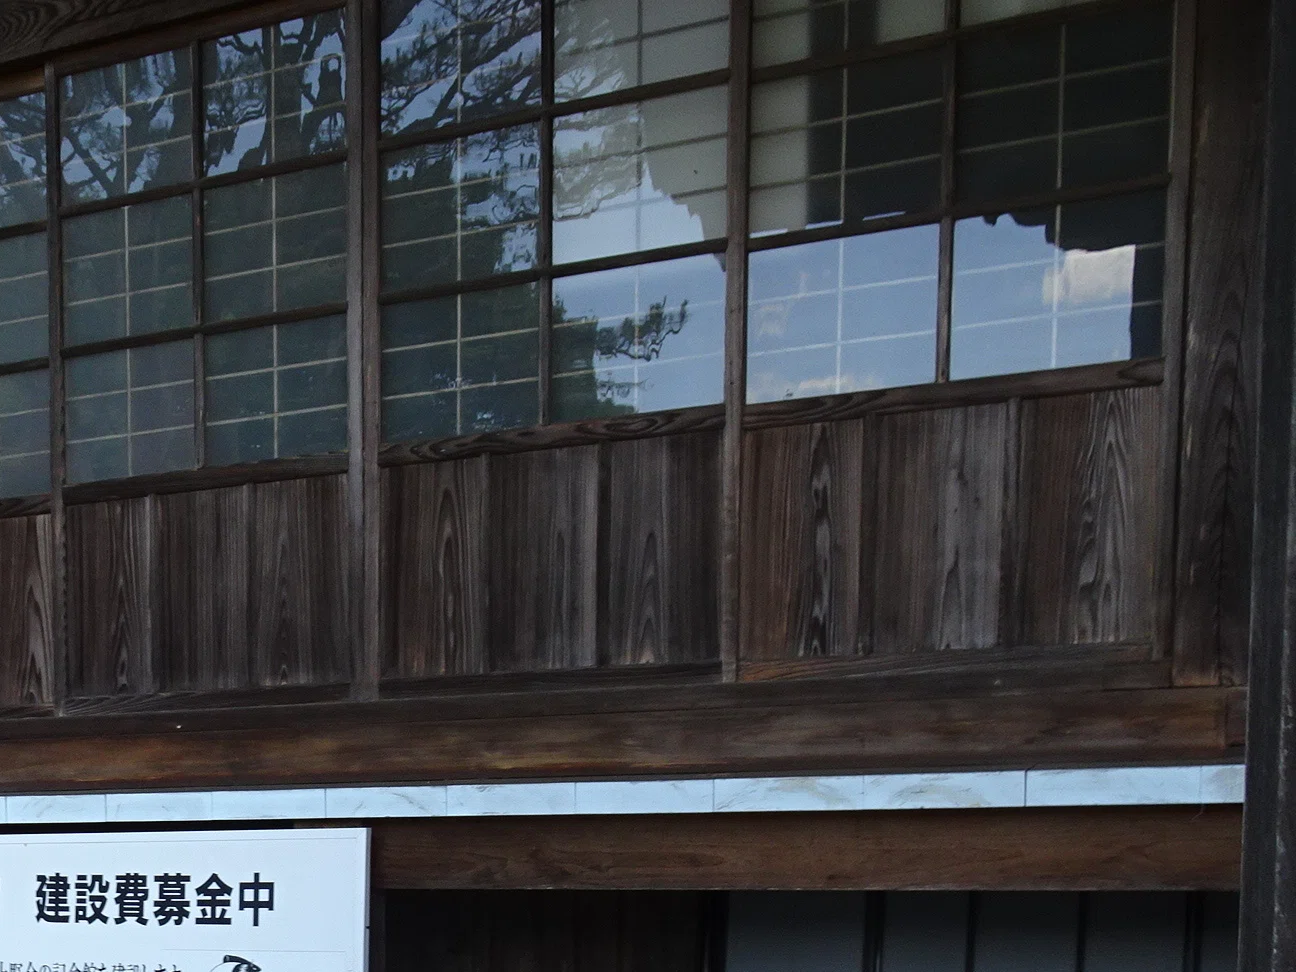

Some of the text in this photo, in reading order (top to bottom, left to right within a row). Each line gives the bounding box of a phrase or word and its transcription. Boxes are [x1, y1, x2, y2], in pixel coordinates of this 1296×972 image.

[35, 872, 275, 927] 建設費募金中
